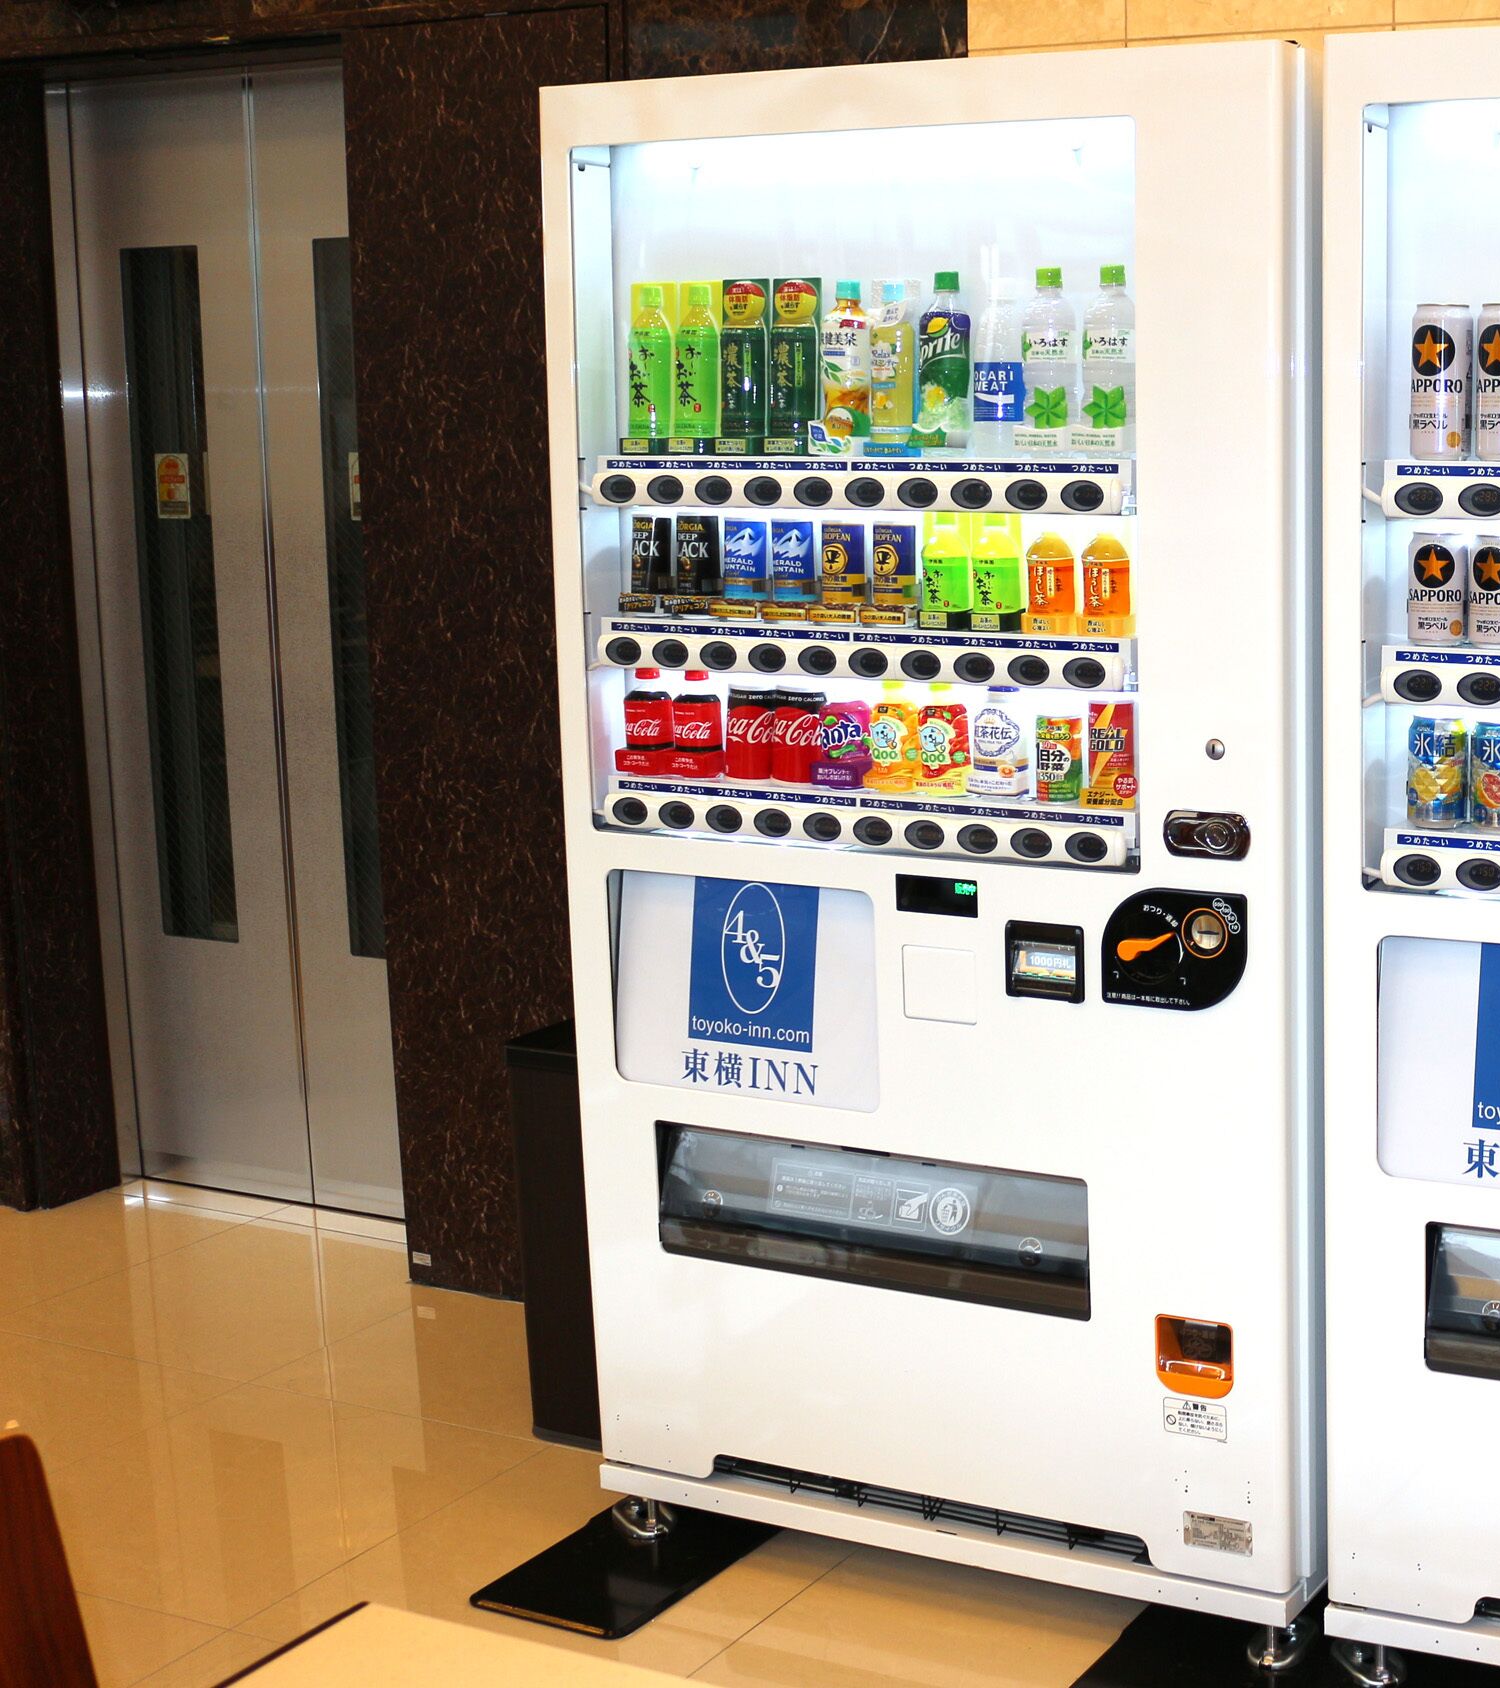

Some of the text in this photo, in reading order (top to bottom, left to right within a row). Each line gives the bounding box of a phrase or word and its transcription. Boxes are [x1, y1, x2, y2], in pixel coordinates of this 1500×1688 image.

[920, 329, 961, 362] prite
[1029, 338, 1068, 347] いろはす
[1089, 337, 1128, 347] いろはす
[974, 370, 1014, 381] OCARI
[974, 381, 1008, 392] WEAT
[1411, 379, 1463, 394] APPORO
[1413, 419, 1448, 430] 黒ラベル
[632, 540, 660, 557] ACK
[678, 541, 709, 558] ACK
[1034, 566, 1048, 605] ほうじ茶
[1088, 567, 1103, 607] ほうじ茶
[1409, 589, 1462, 602] SAPPORO
[1418, 622, 1448, 630] 黒ラベル
[625, 719, 662, 737] ca-Cola
[674, 721, 712, 739] ca-Cola
[820, 720, 863, 750] anta
[1090, 725, 1126, 739] REAL
[1090, 739, 1125, 751] GOLD
[1414, 733, 1456, 758] 氷結
[872, 748, 898, 760] Qoo
[920, 751, 946, 763] Qoo
[724, 909, 781, 989] 4&5
[1029, 955, 1072, 970] 1000円札
[691, 1015, 810, 1044] toyoko-inn.com
[680, 1048, 819, 1096] 東横INN
